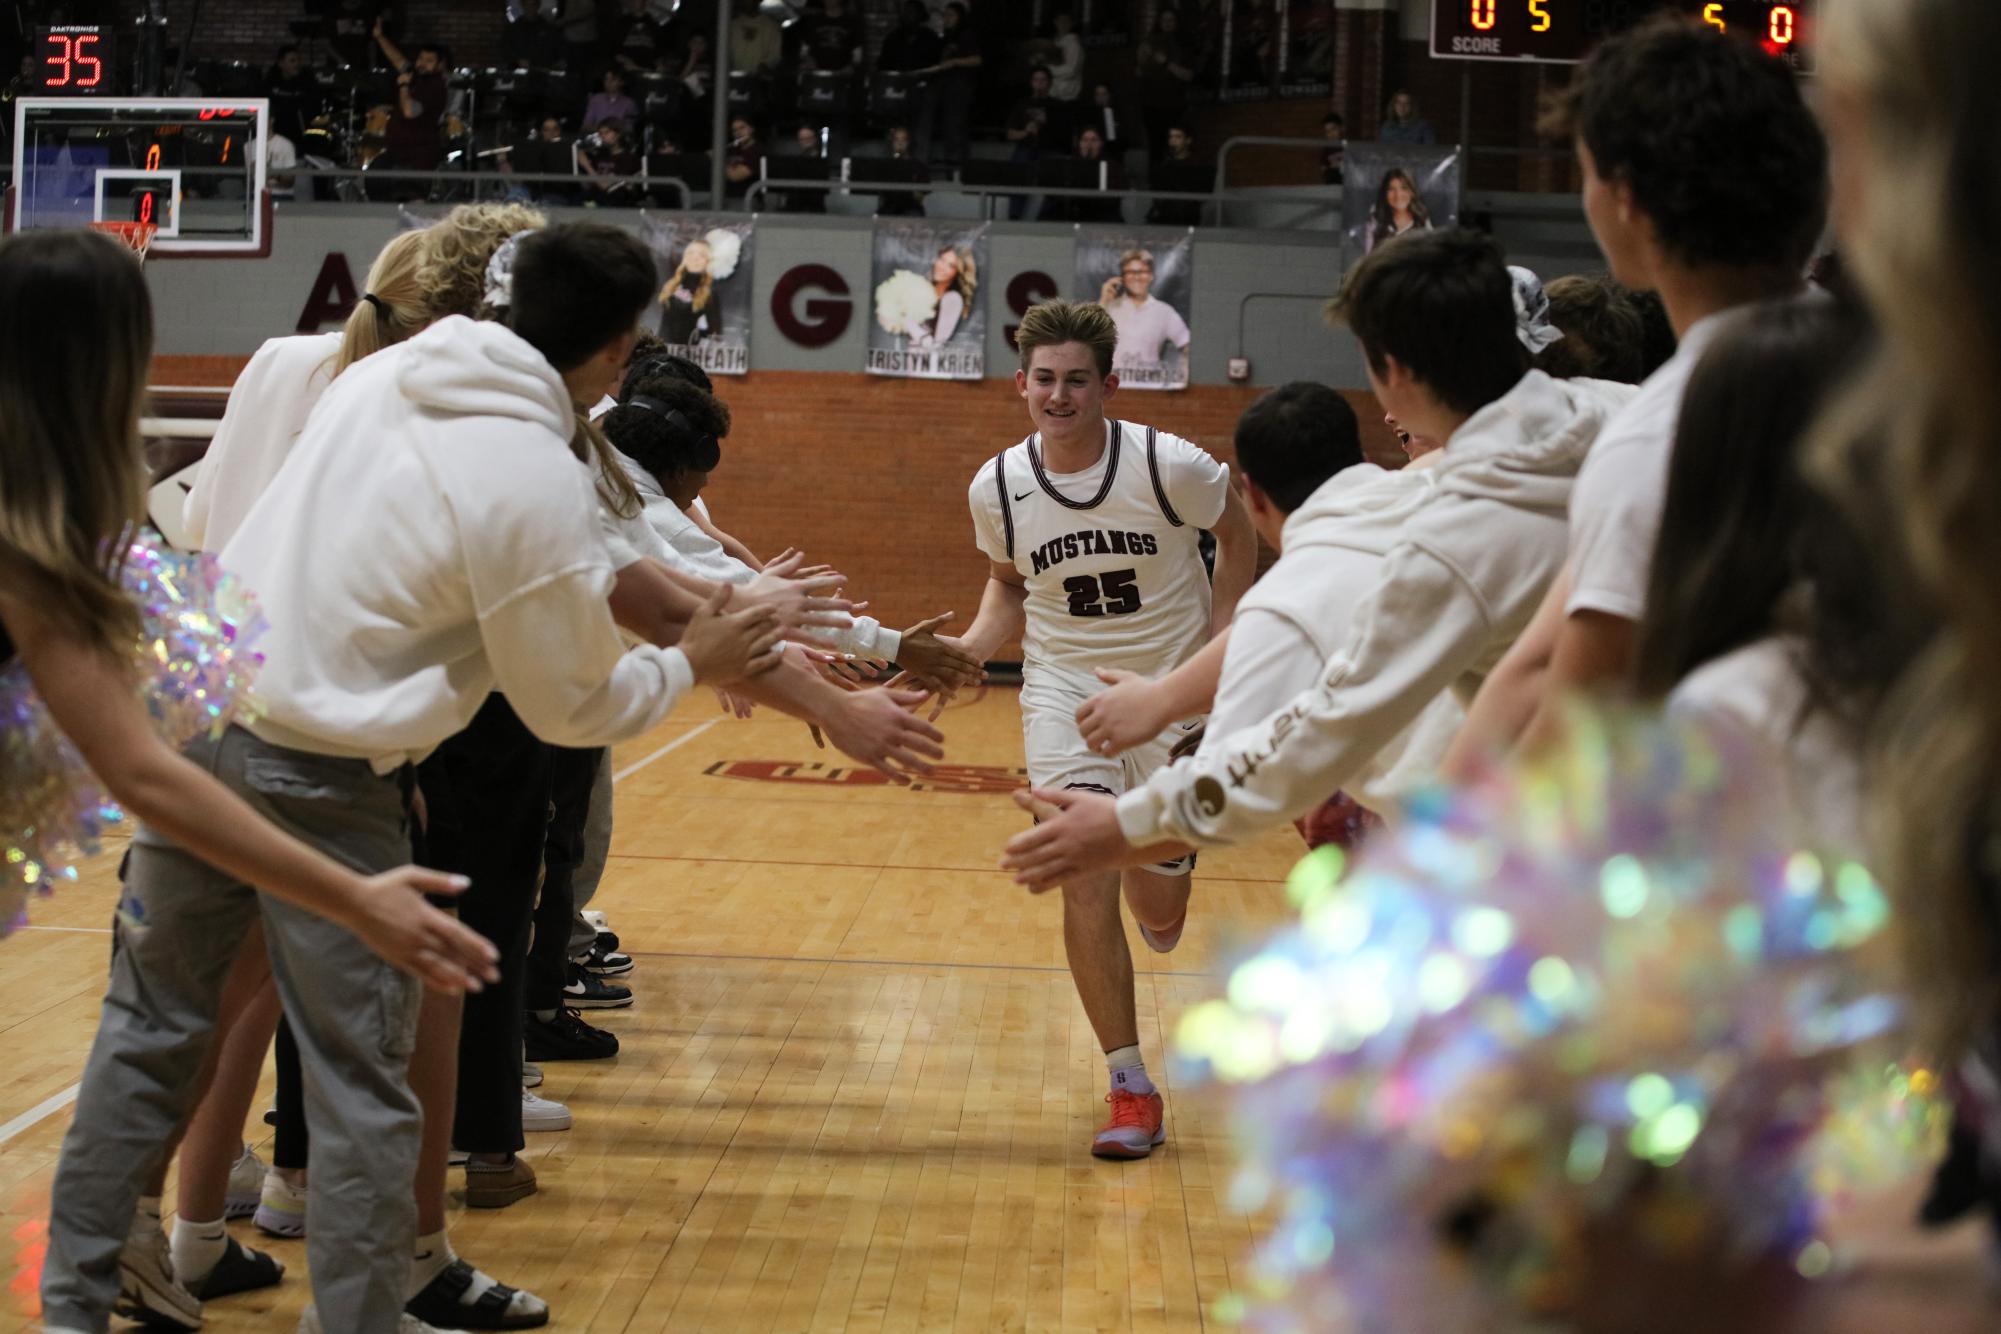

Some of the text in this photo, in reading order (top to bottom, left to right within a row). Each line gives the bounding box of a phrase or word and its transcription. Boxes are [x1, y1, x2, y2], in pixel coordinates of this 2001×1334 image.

[1471, 0, 1495, 29] 0
[1528, 0, 1551, 32] 5
[1770, 6, 1793, 43] 0
[46, 35, 101, 86] 35
[1452, 36, 1501, 53] SCORE
[296, 252, 359, 333] A
[770, 263, 853, 350] G
[868, 349, 930, 373] TRISTYN
[1030, 529, 1159, 576] MUSTANGS
[1062, 568, 1143, 617] 25
